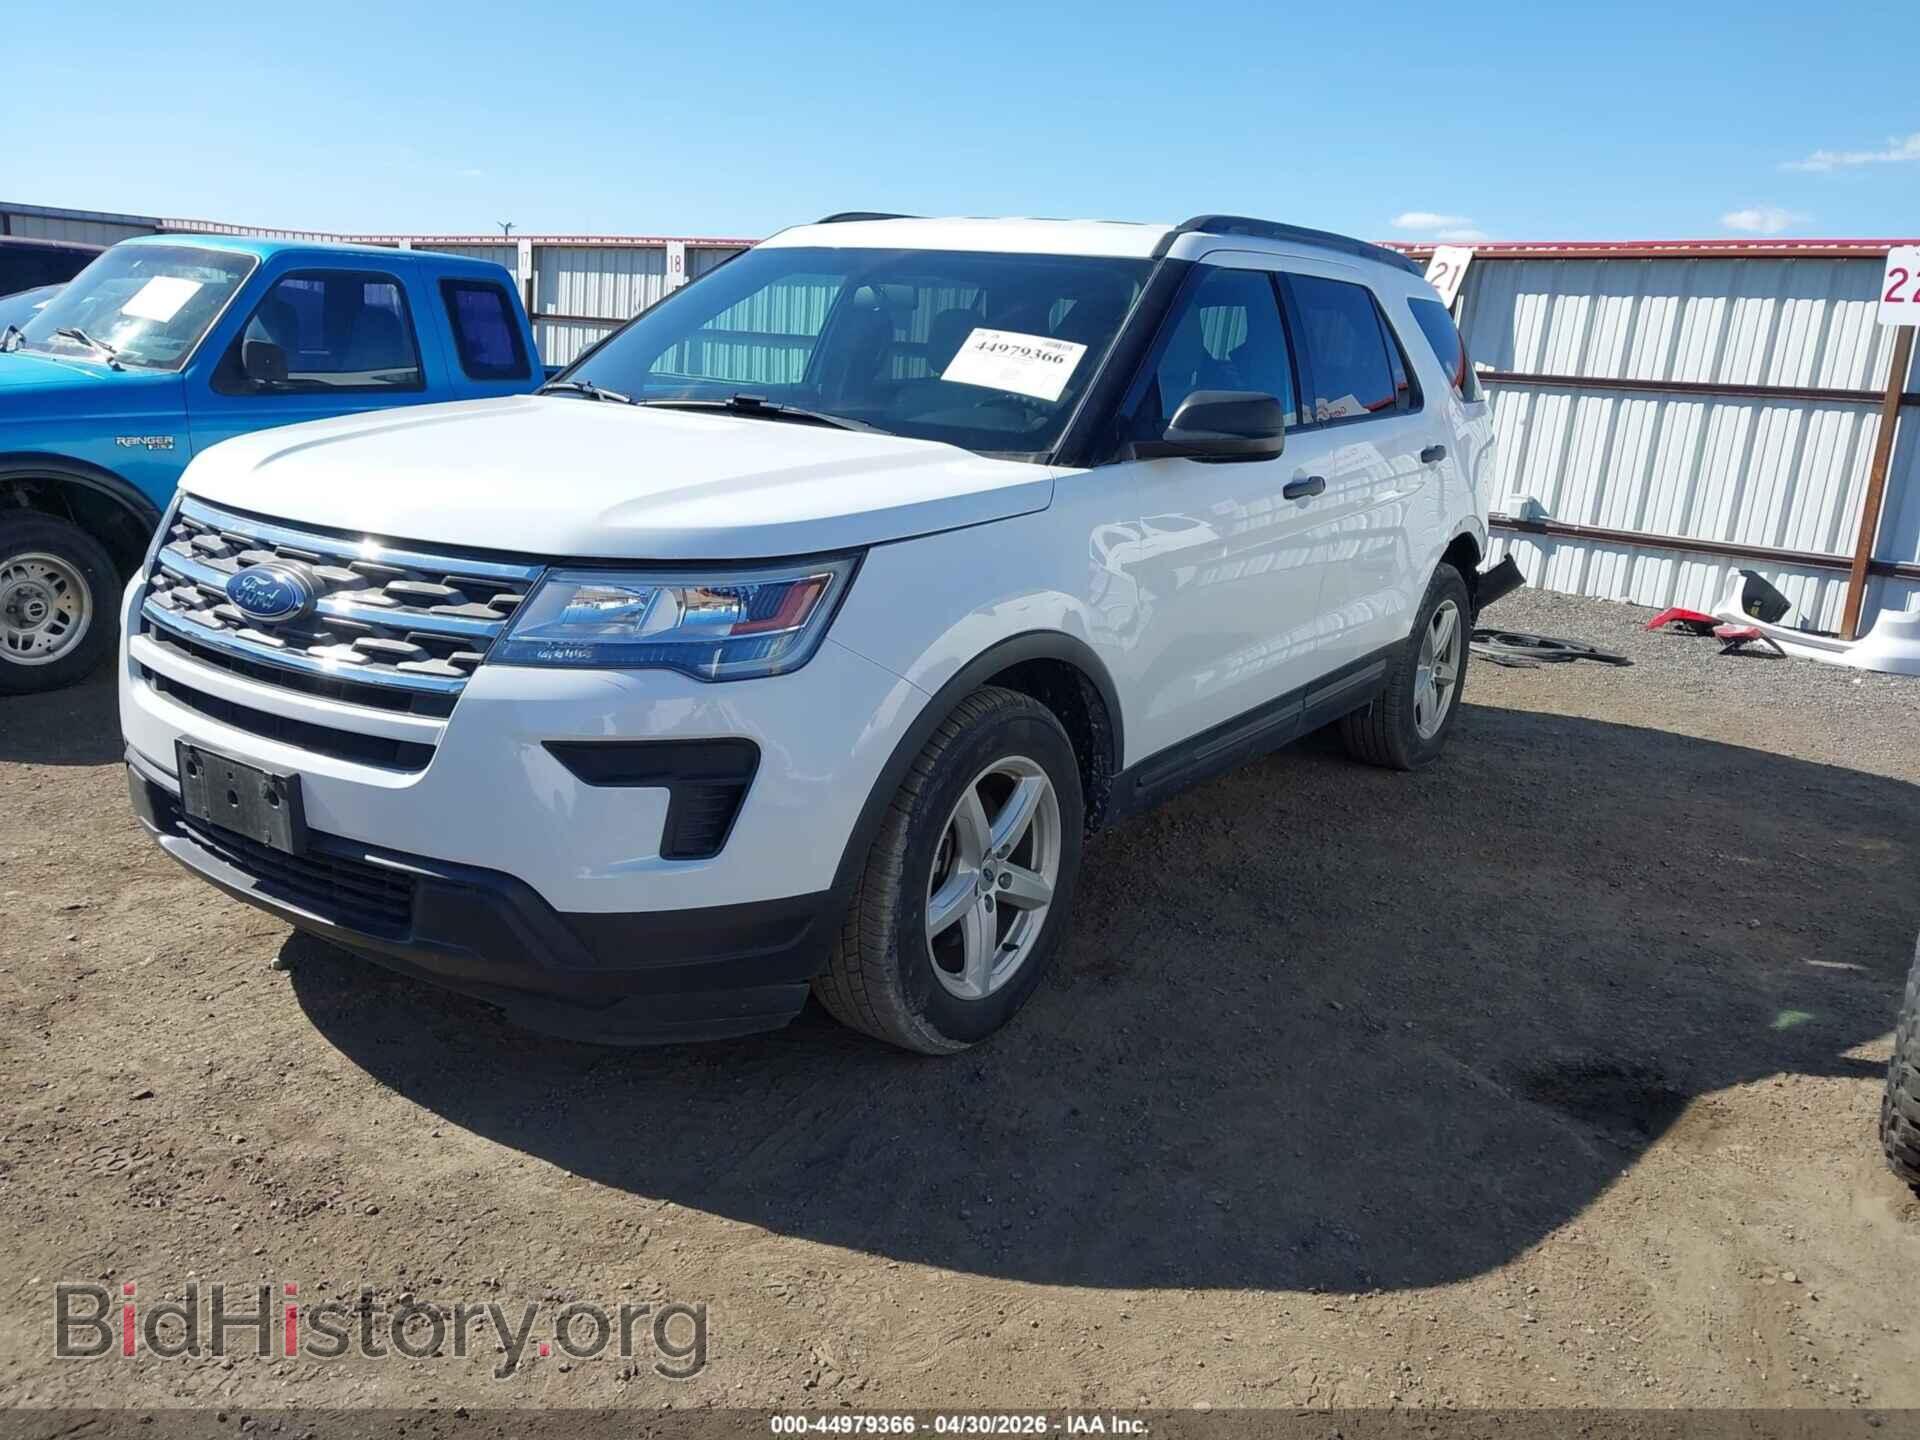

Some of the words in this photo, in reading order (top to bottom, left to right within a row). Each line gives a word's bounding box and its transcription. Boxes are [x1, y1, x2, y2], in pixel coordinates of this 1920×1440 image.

[670, 255, 681, 272] 18
[1431, 262, 1461, 291] 21
[975, 341, 1064, 364] 44979366
[116, 436, 173, 447] RANGER
[235, 575, 281, 609] Ford
